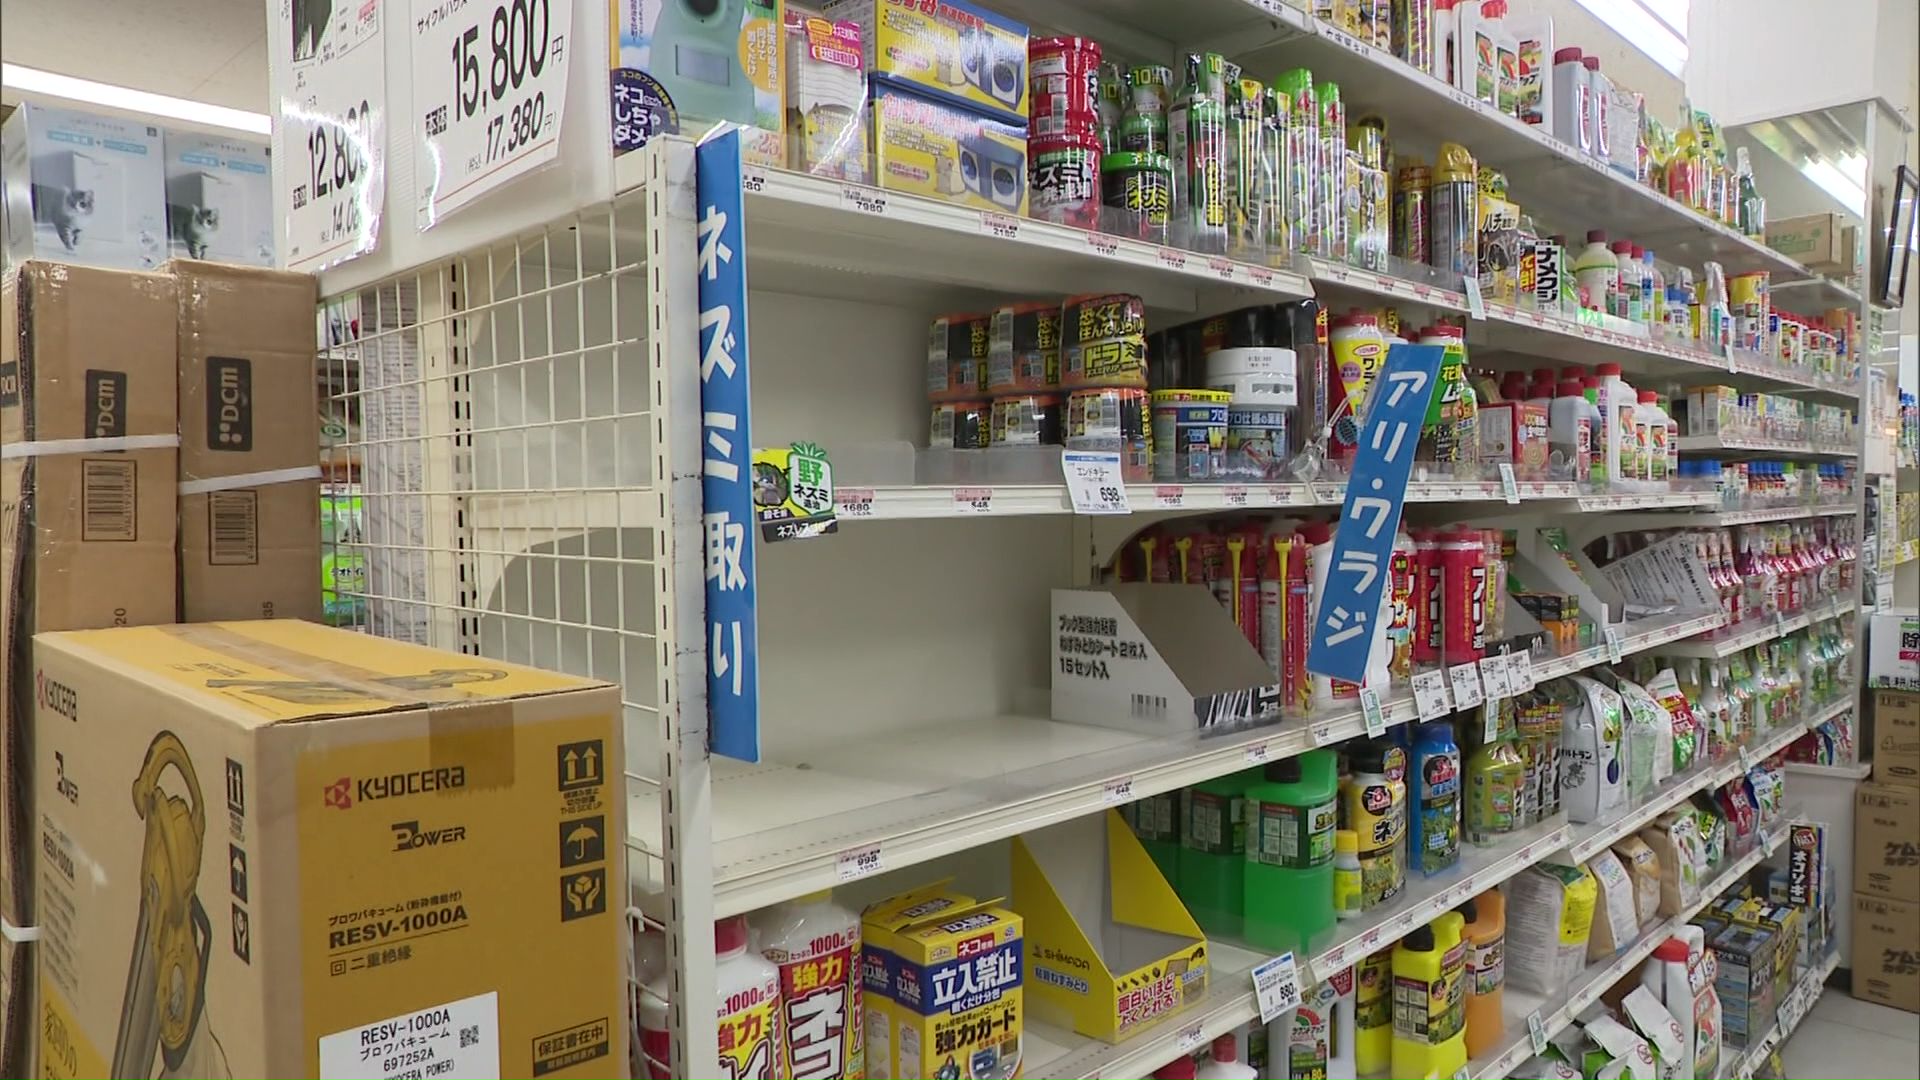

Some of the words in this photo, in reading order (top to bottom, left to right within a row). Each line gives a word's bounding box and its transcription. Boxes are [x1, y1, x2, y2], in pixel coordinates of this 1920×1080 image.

[452, 0, 549, 122] 15,800
[551, 35, 564, 65] 円
[1134, 68, 1152, 85] 10
[1208, 55, 1222, 74] 10
[615, 84, 643, 104] ネコ
[486, 91, 545, 165] 17,380
[615, 102, 661, 130] しちゃ
[743, 181, 762, 192] 80
[856, 200, 883, 213] 7980
[1482, 213, 1502, 232] ハチ
[1536, 247, 1558, 303] ナメクジ
[698, 204, 747, 696] ネズミ取り
[797, 458, 824, 487] 野
[843, 503, 870, 512] 1680
[1100, 487, 1120, 501] 698
[1326, 370, 1428, 648] アリ・ワラジ
[357, 766, 465, 802] KYOCERA
[857, 855, 878, 867] 998
[329, 905, 468, 949] RESV-1000A
[350, 945, 413, 971] 二重絶縁
[791, 956, 843, 993] 強力
[931, 947, 1017, 1007] 立入禁止
[1117, 971, 1176, 1014] 面白いほど
[1280, 982, 1295, 1000] 880
[361, 1009, 450, 1047] RESV-1000A
[538, 1025, 604, 1058] 保証書在中
[934, 1006, 1016, 1057] 強力ガード
[360, 1027, 451, 1062] ブロワバキューム
[383, 1047, 434, 1072] 697252A
